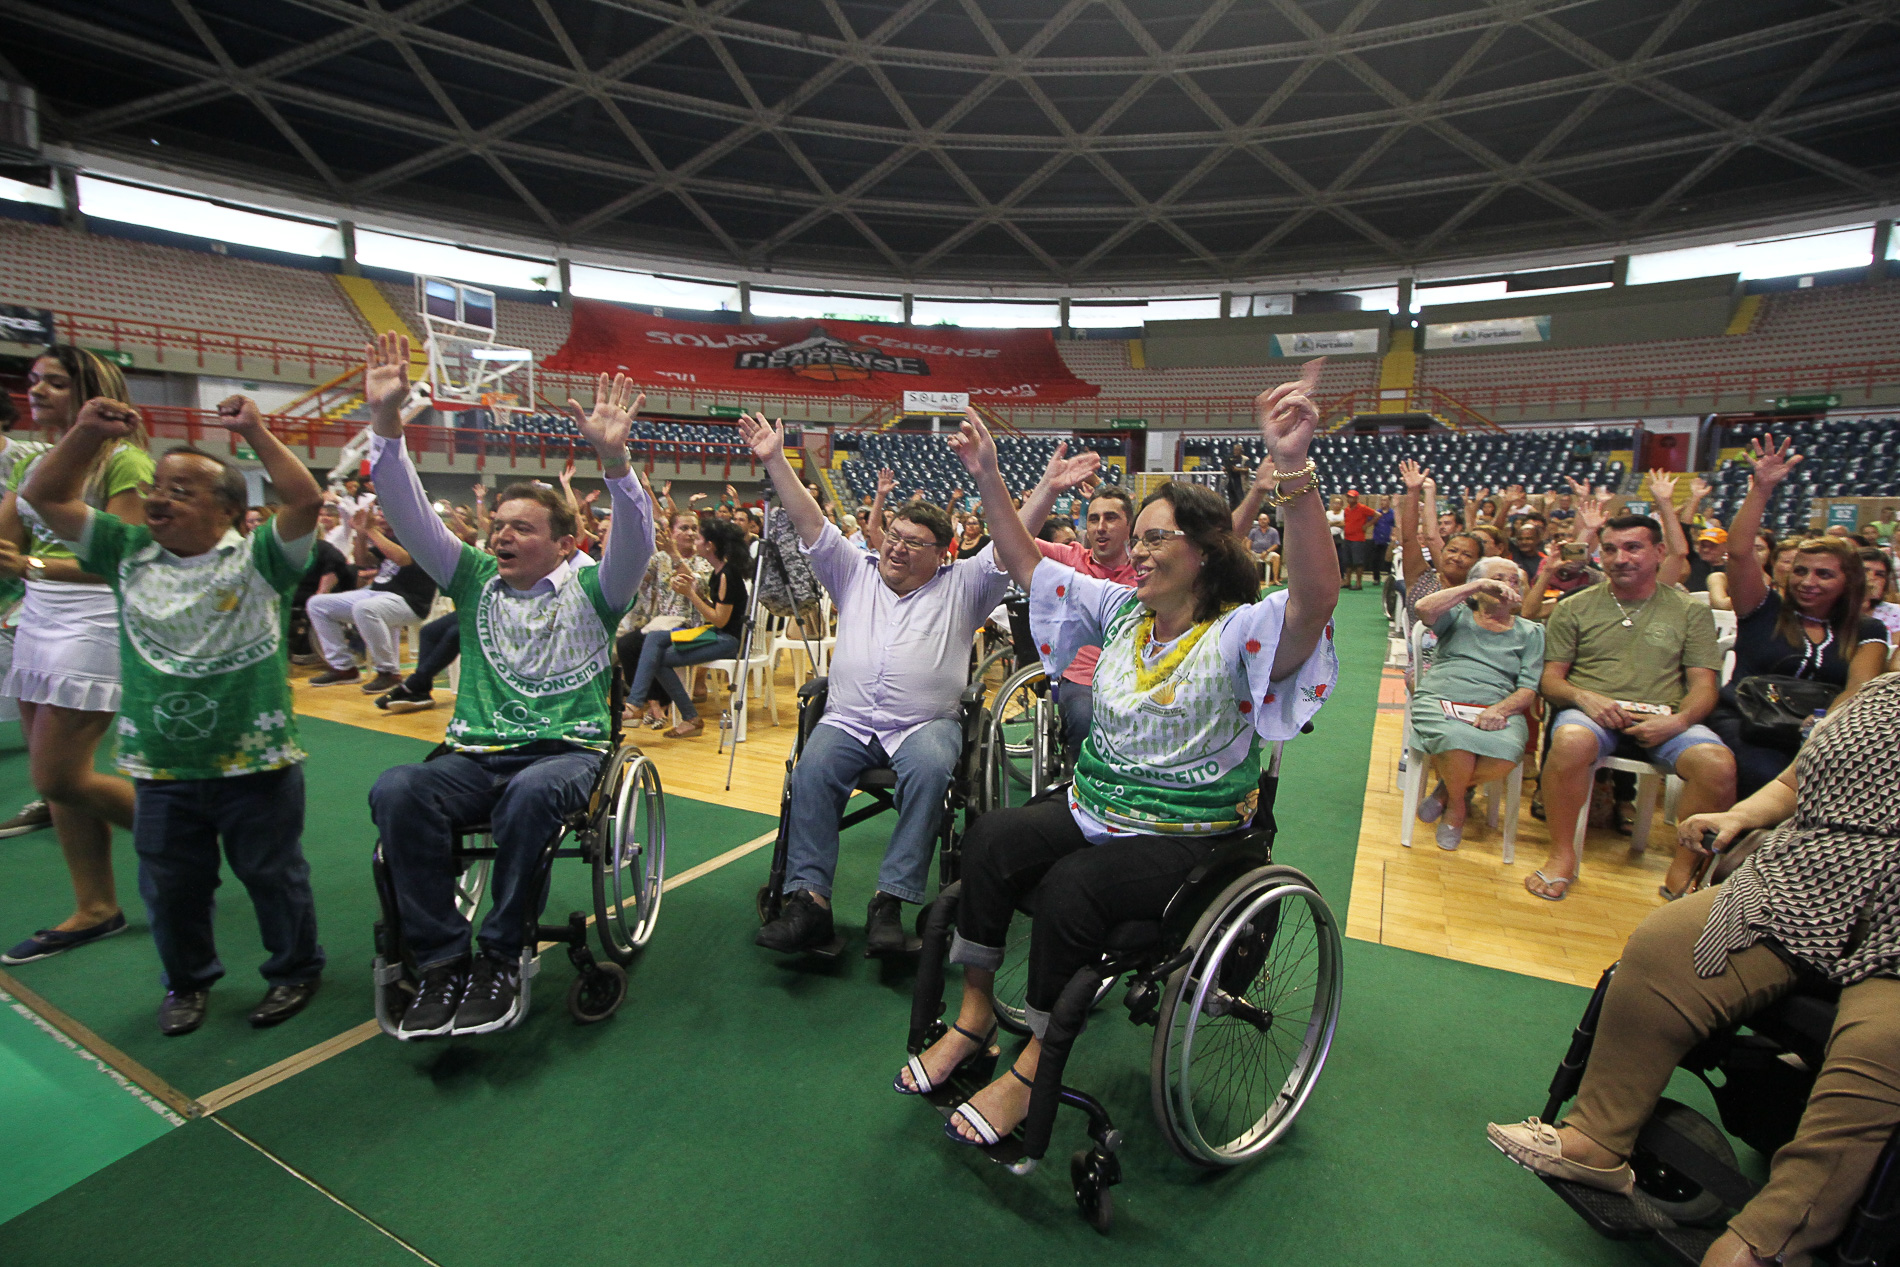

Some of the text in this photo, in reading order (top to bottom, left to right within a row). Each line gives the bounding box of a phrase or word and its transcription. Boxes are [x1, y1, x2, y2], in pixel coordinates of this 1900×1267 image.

[645, 330, 779, 349] SOLAR
[858, 334, 1002, 359] CEARENSE
[909, 392, 960, 403] SOLAR
[496, 662, 508, 674] O
[1095, 734, 1103, 749] O
